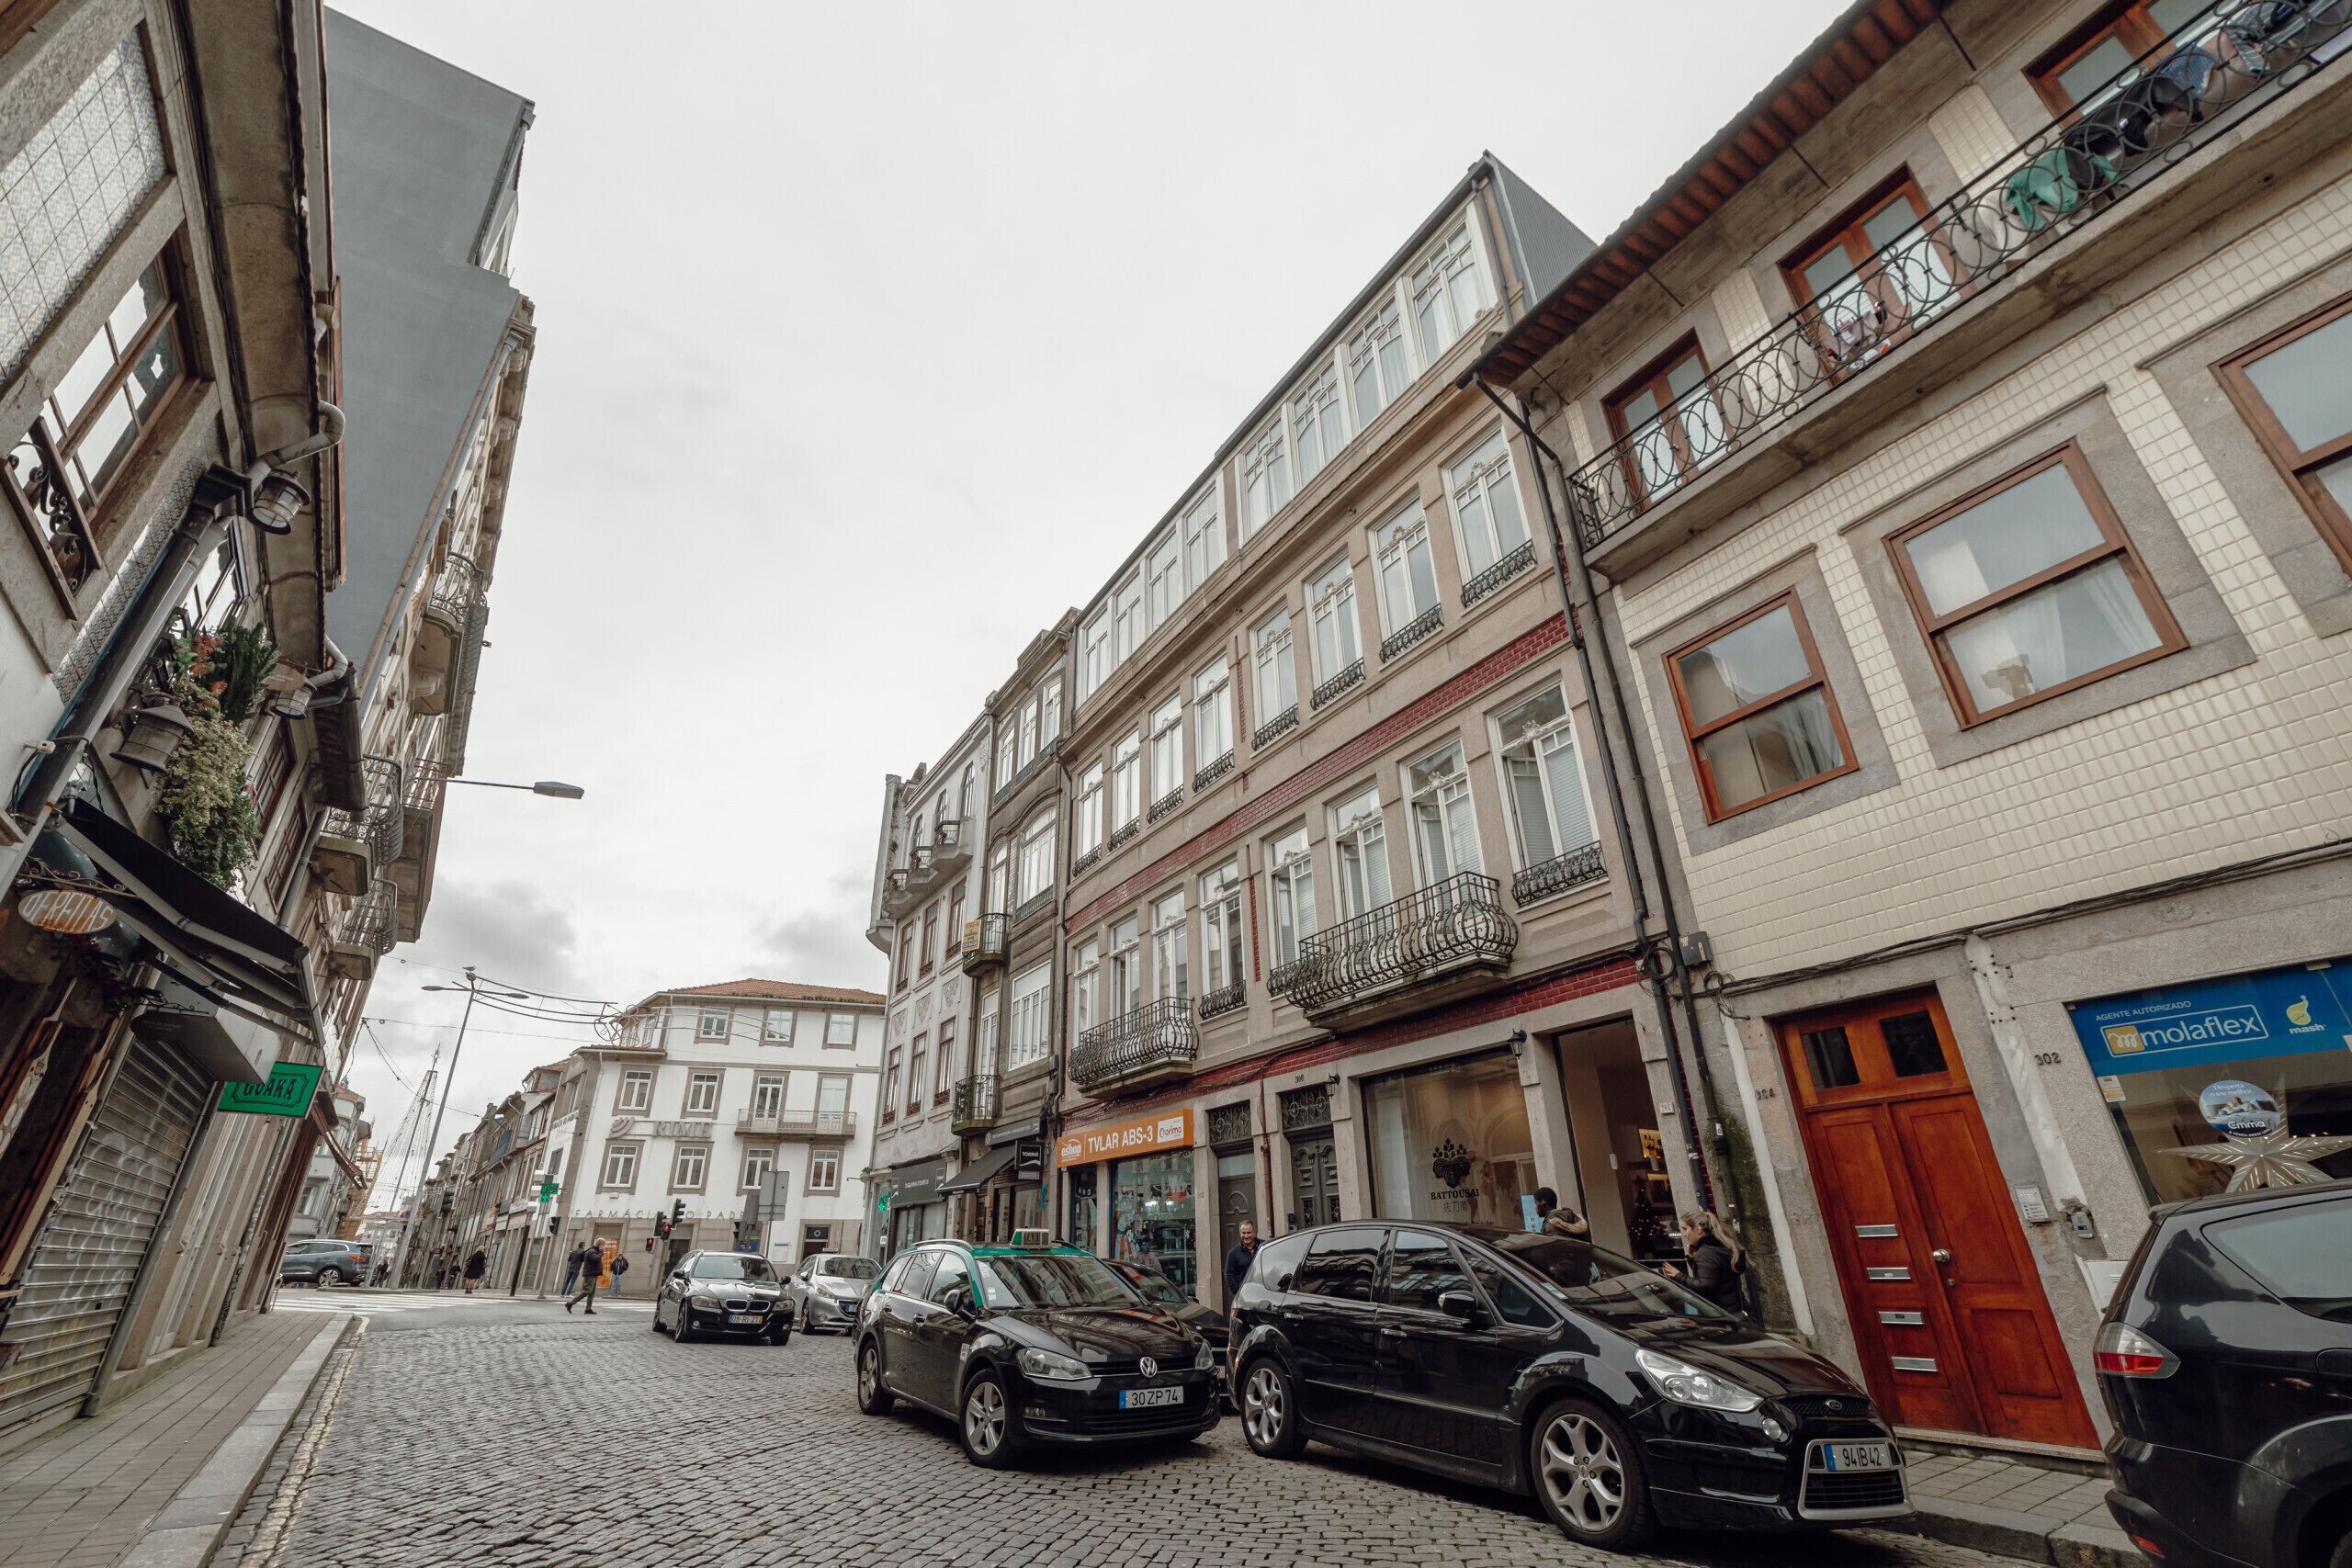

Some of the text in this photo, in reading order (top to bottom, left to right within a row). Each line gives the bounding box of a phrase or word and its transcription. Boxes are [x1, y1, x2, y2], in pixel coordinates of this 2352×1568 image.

[2096, 1000, 2191, 1021] AGENTE AUTORIZADO
[2140, 1016, 2261, 1047] molaflex
[2289, 1023, 2324, 1034] mash
[2034, 1052, 2062, 1066] 302
[1088, 1125, 1153, 1153] TVLAR ABS-3
[1430, 1189, 1479, 1201] BATTOUSAI
